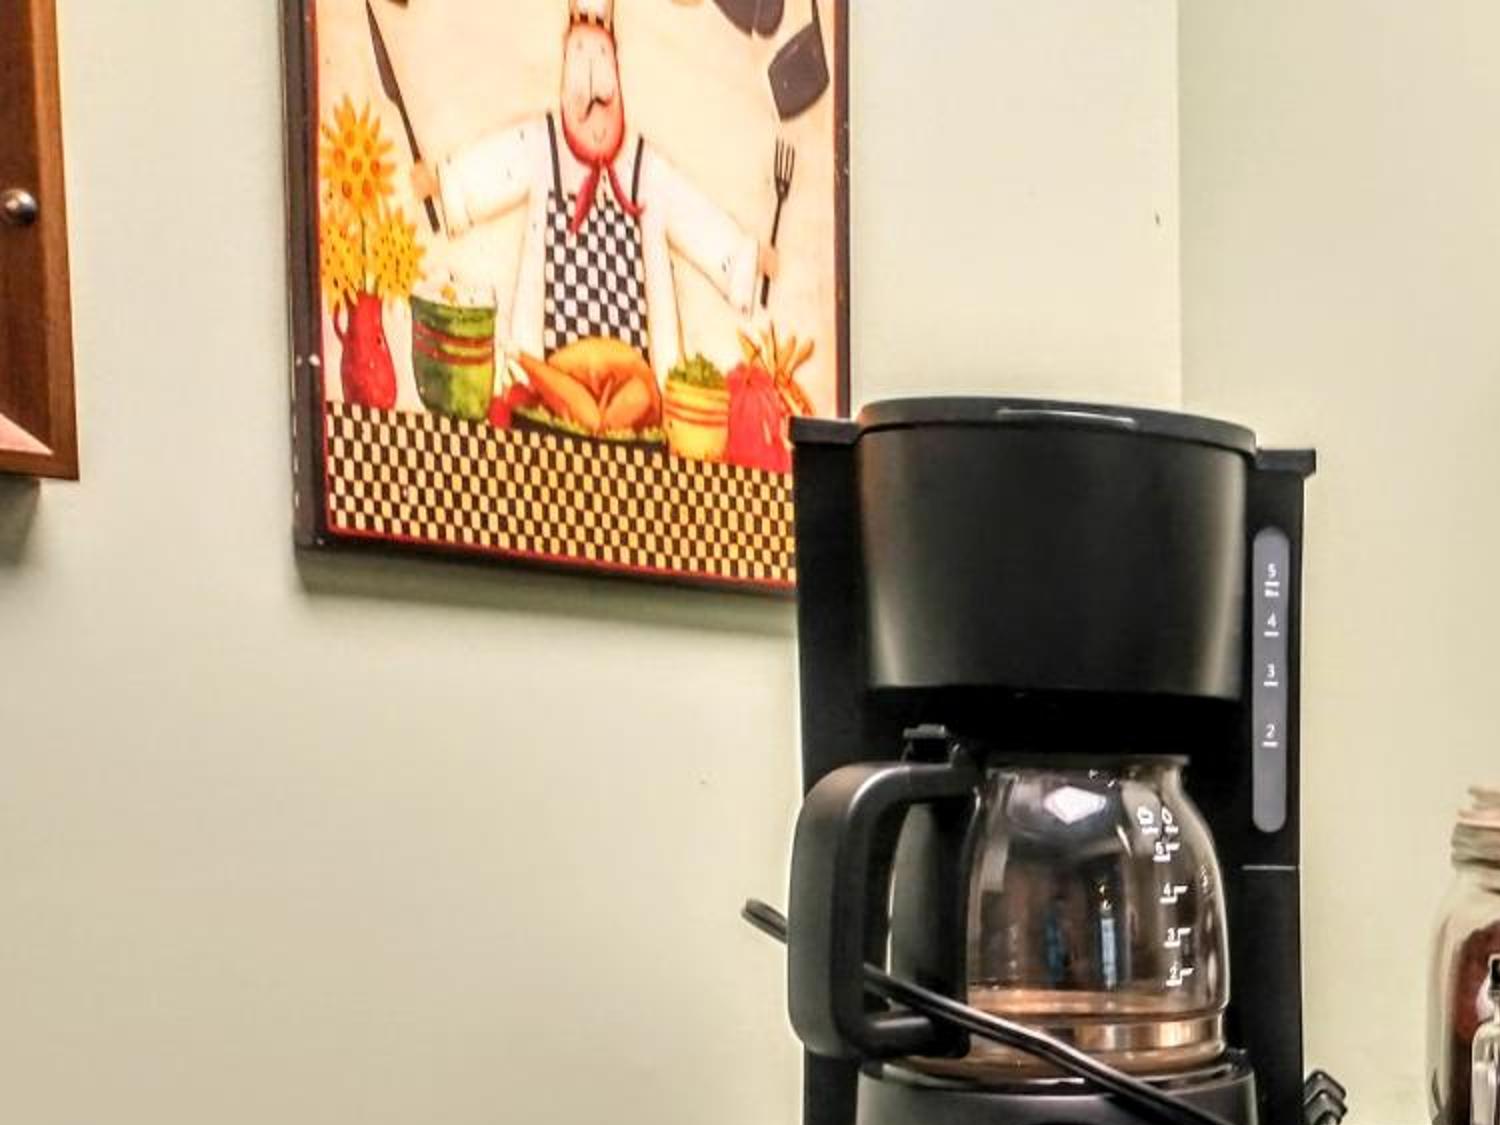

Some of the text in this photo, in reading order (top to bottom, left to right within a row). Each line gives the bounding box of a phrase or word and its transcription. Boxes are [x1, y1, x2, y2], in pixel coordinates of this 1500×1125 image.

[1267, 563, 1277, 578] 5
[1267, 613, 1277, 628] 4
[1267, 664, 1276, 679] 3
[1266, 724, 1276, 739] 2
